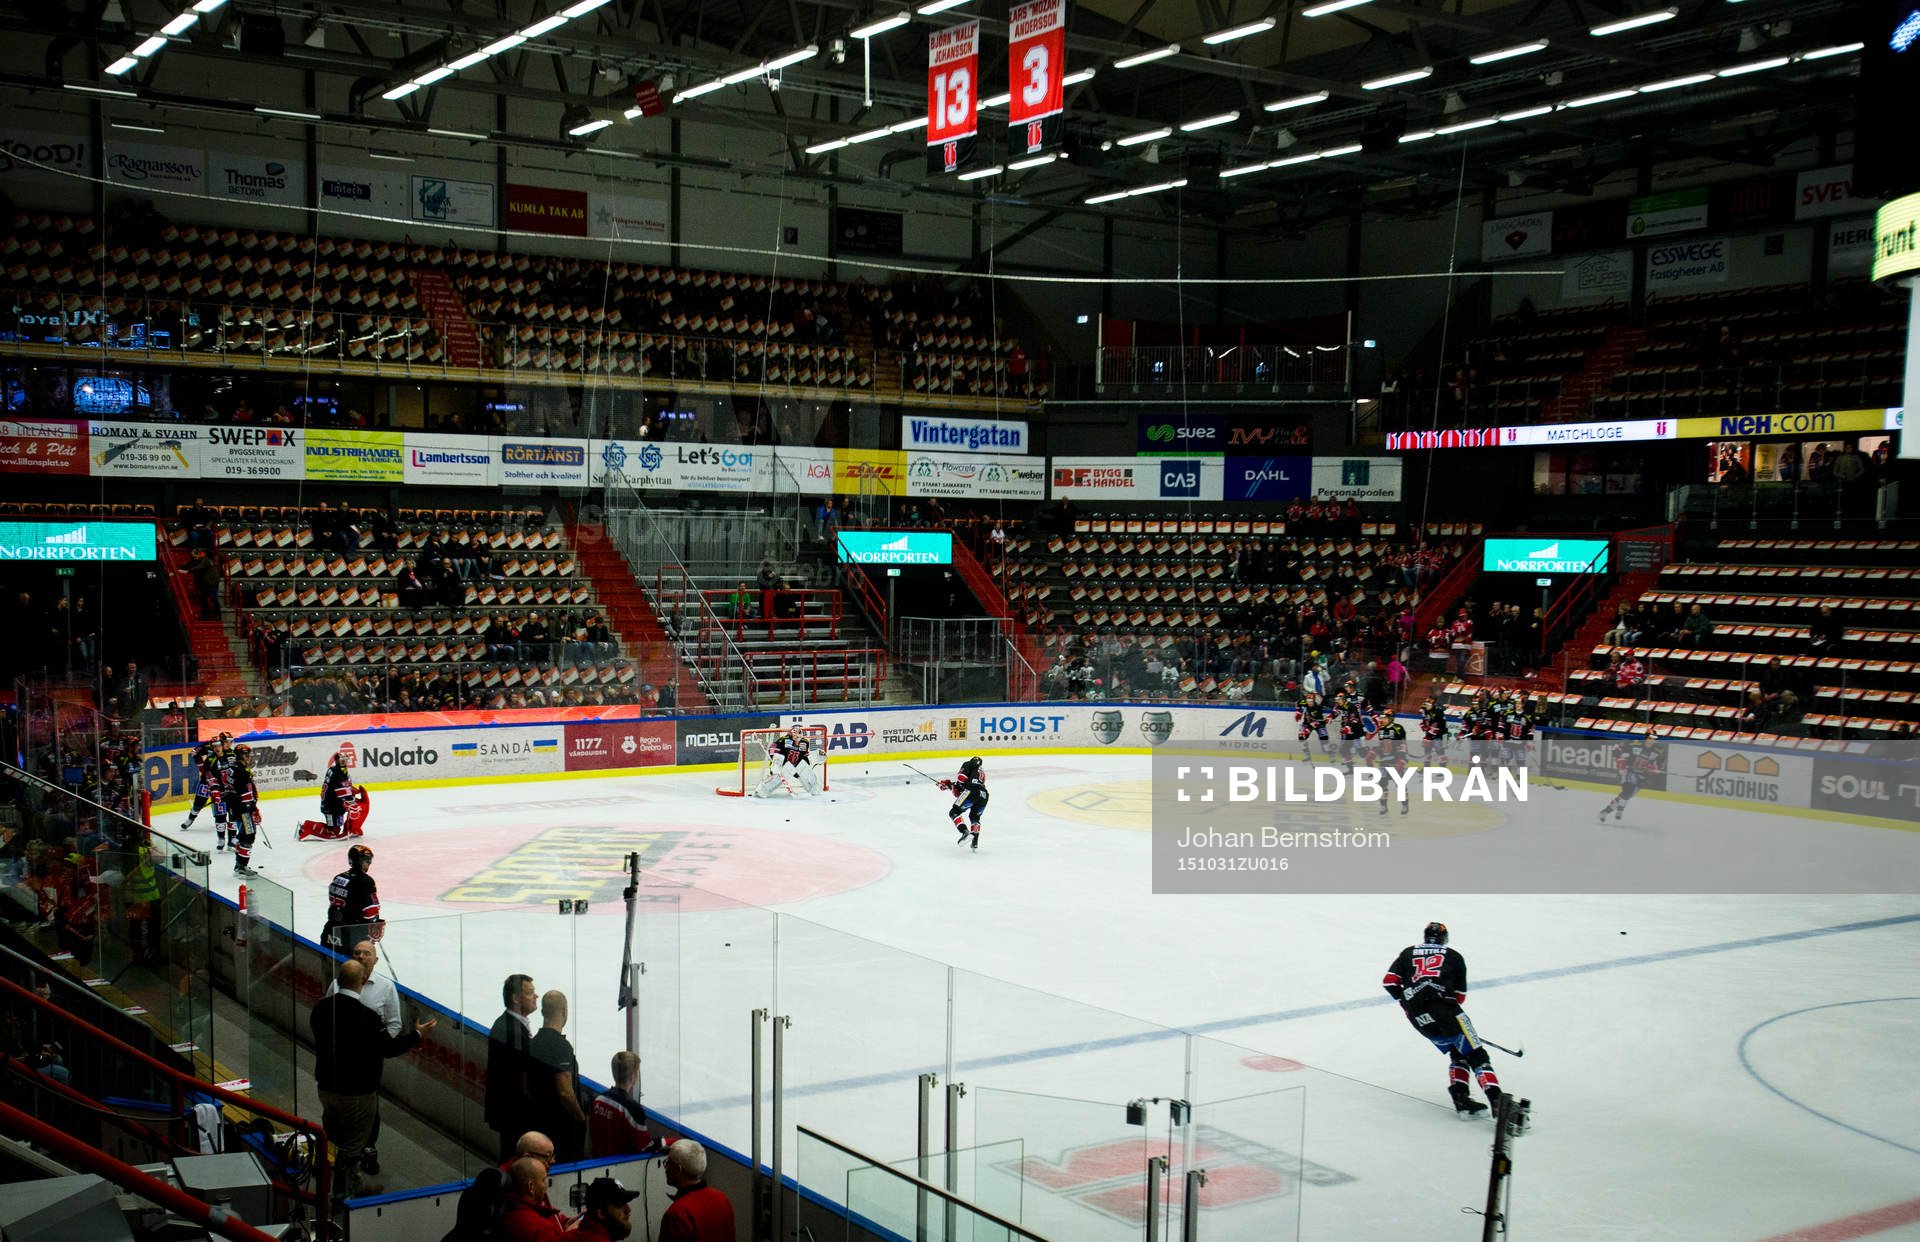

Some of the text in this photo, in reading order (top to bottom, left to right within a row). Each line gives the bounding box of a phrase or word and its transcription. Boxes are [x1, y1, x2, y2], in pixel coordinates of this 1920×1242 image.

[1023, 44, 1048, 107] 3
[934, 67, 970, 130] 13
[108, 154, 201, 180] Ragnarsson
[225, 169, 285, 189] Thomas
[509, 201, 584, 219] KUMLA TAK AB
[1651, 241, 1722, 266] ESSWEGE
[1710, 261, 1725, 273] AB
[92, 427, 198, 439] BOMAN & SVAHN
[911, 420, 1020, 449] Vintergatan
[1548, 427, 1623, 440] MATCHLOGE
[419, 452, 490, 464] Lambertsson
[506, 446, 580, 462] RÖRTJÄNST
[678, 446, 720, 465] Let's
[535, 470, 549, 479] och
[807, 464, 831, 478] AGA
[845, 465, 894, 479] DHL
[1019, 470, 1044, 480] weber
[1093, 468, 1121, 478] BYGG
[1244, 469, 1290, 481] DAHL
[1093, 479, 1135, 488] HANDEL
[1164, 472, 1196, 487] CAB
[1318, 488, 1395, 499] Personalpoolen
[851, 552, 939, 563] NORRPORTEN
[1497, 559, 1594, 573] NORRPORTEN
[980, 716, 1065, 734] HOIST
[1091, 721, 1124, 732] GOLF
[1140, 722, 1174, 733] GOLF
[575, 738, 602, 750] 1177
[639, 736, 661, 746] Region
[883, 733, 938, 744] TRUCKAR
[1218, 741, 1268, 749] MIDROC
[480, 742, 532, 755] SANDÅ
[363, 746, 438, 768] Nolato
[1696, 775, 1779, 802] EKSJÖHUS
[1820, 775, 1890, 801] SOUL
[1412, 954, 1445, 983] 12
[1415, 1012, 1436, 1027] NA
